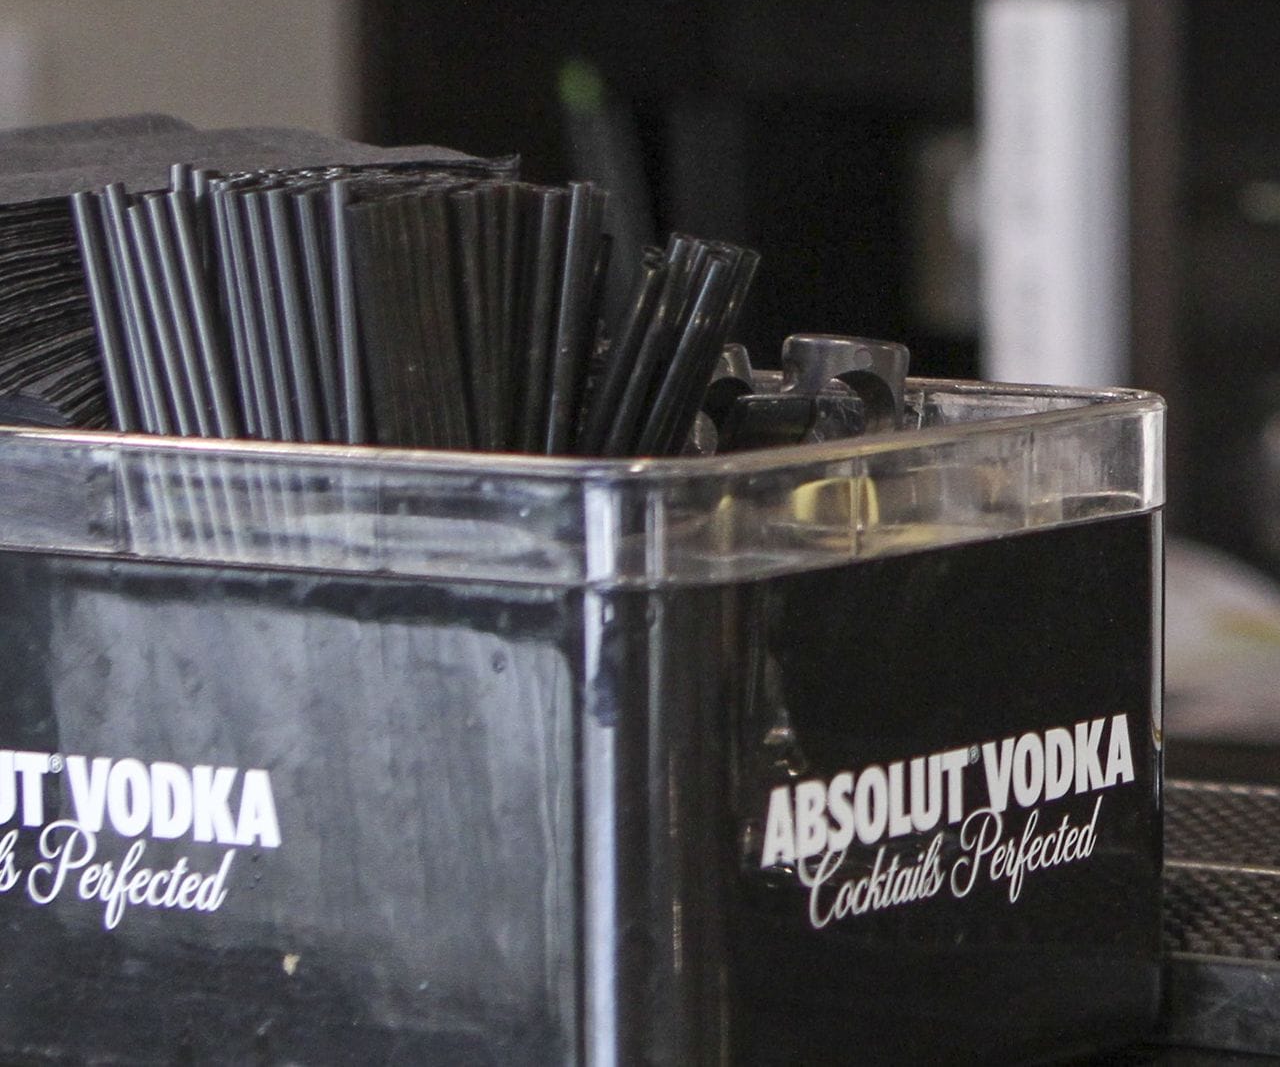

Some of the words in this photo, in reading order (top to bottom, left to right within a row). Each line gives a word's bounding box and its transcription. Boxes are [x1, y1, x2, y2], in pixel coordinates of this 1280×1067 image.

[65, 754, 282, 848] VODKA
[982, 713, 1135, 812] VODKA
[27, 819, 236, 930] Perfected
[796, 832, 946, 929] Cocktails
[950, 795, 1103, 903] Perfected
